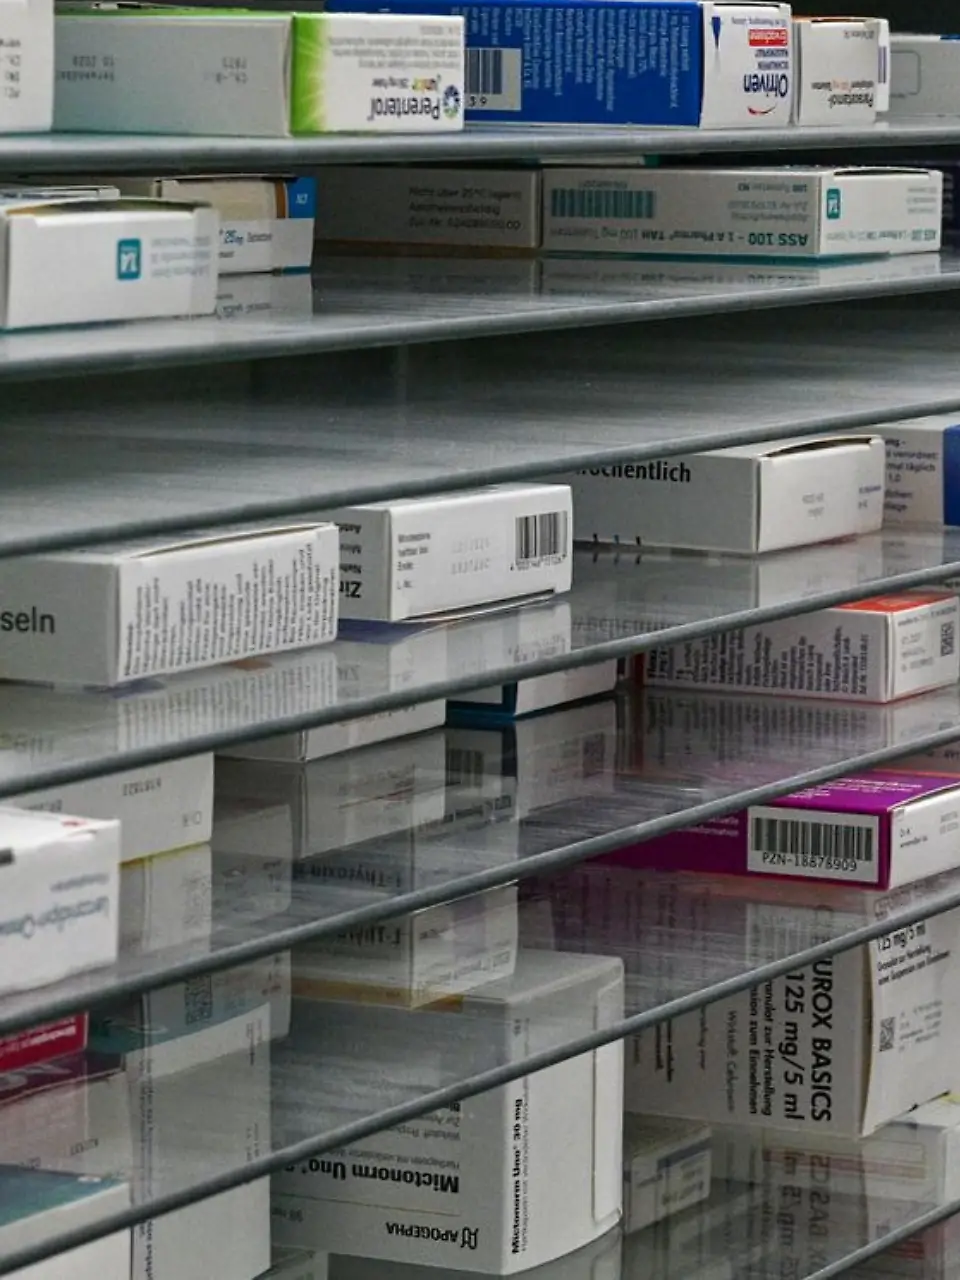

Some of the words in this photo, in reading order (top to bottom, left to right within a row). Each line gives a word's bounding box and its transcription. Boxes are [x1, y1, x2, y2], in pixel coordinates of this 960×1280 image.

[743, 73, 788, 98] Otriven
[370, 97, 440, 121] Perenterol
[748, 231, 774, 247] 100
[778, 232, 808, 247] ASS
[764, 979, 775, 1022] ranulat
[785, 973, 804, 1013] 125
[812, 959, 833, 1030] UROX
[749, 1020, 758, 1046] zum
[764, 1026, 773, 1046] zur
[778, 1022, 804, 1085] mg/5
[749, 1049, 758, 1115] Einnehmen
[761, 1049, 774, 1116] Herstellung
[810, 1037, 832, 1122] BASICS
[784, 1094, 804, 1120] ml
[351, 1165, 459, 1194] Mictonorm
[385, 1221, 458, 1243] APOGEPHA
